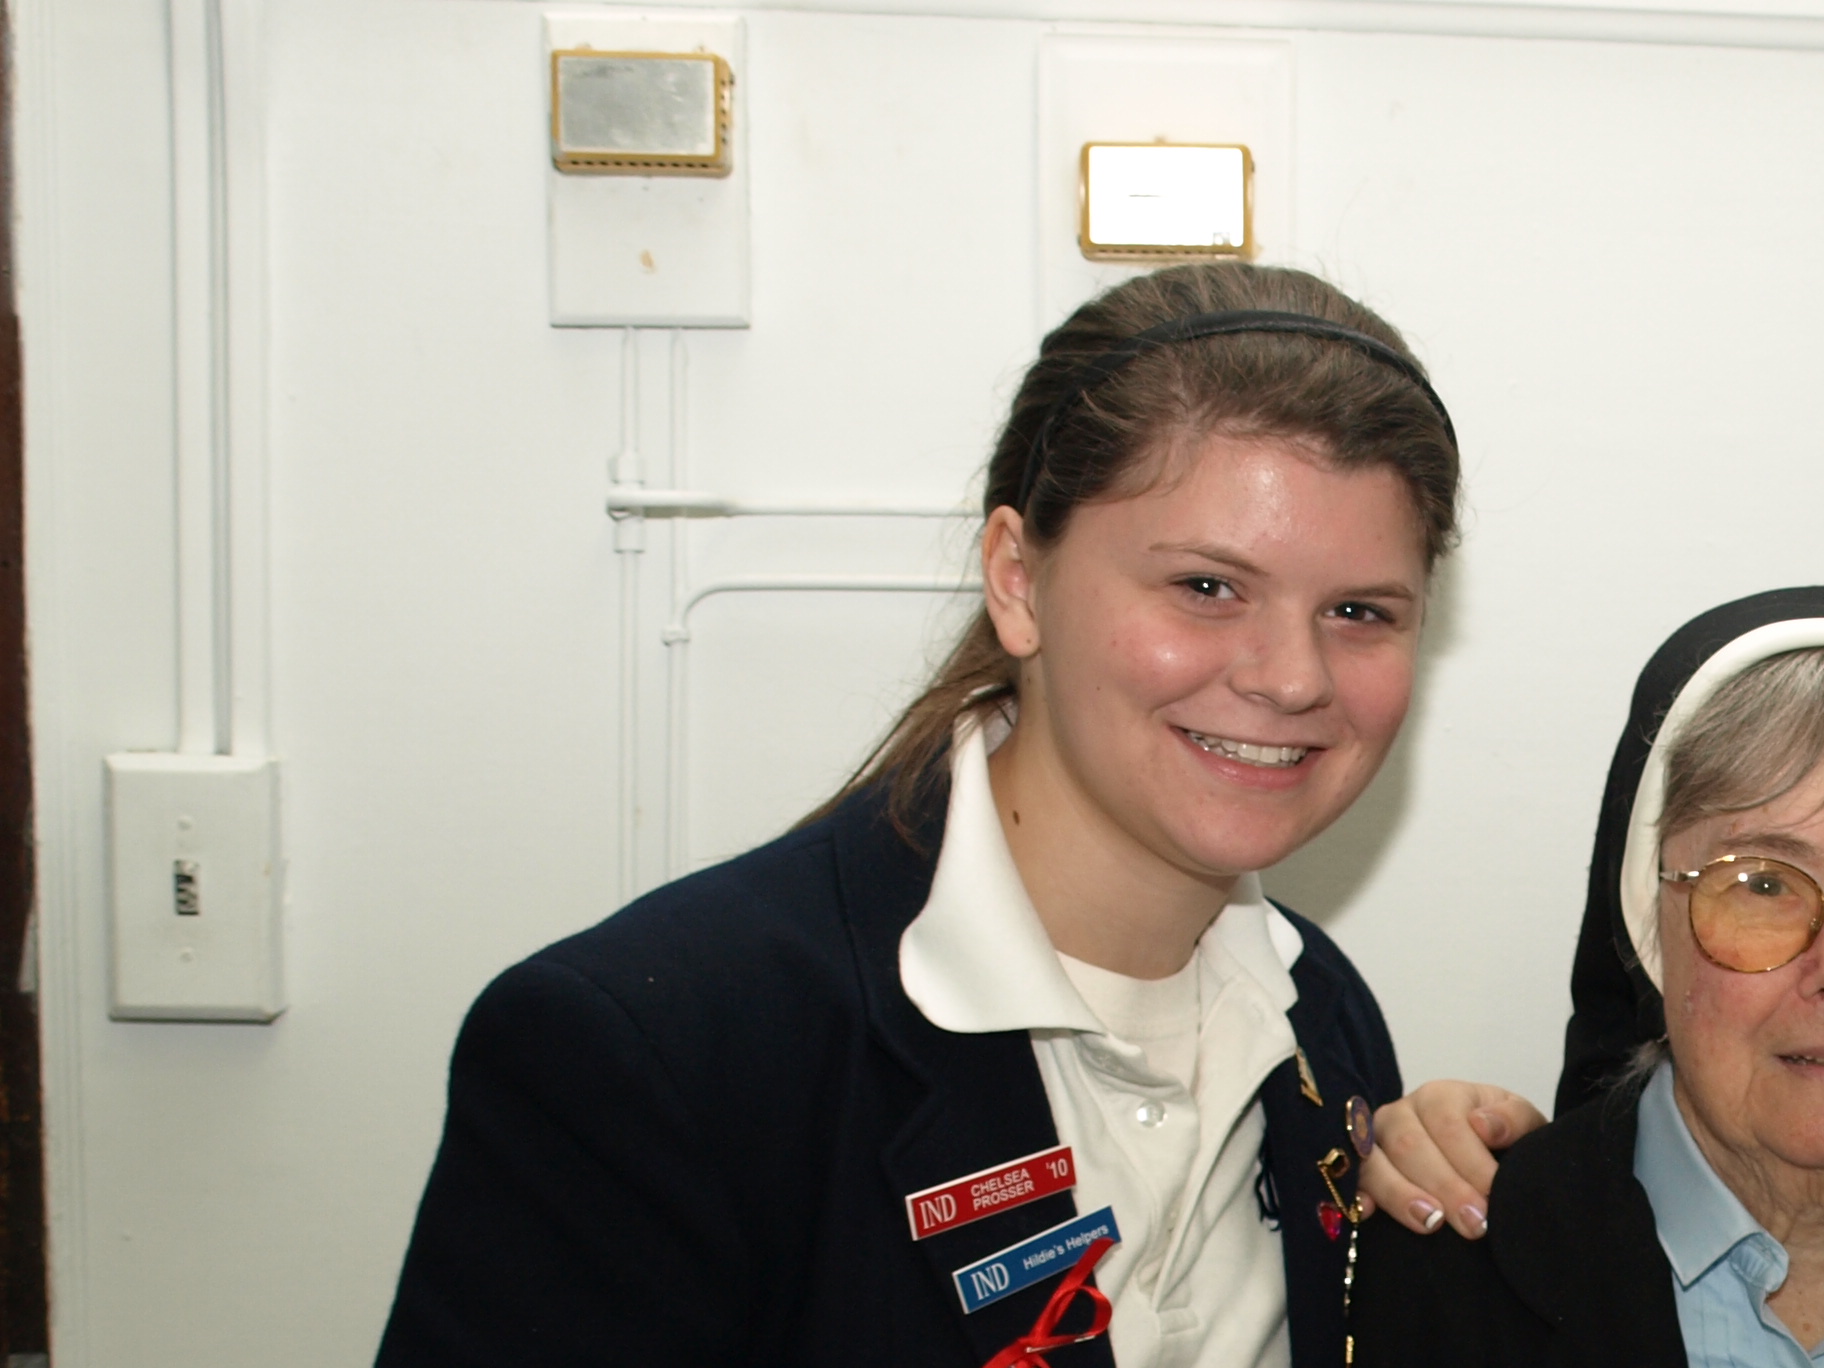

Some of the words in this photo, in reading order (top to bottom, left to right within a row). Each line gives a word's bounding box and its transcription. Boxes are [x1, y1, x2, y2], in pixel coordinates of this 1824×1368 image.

[970, 1168, 1030, 1197] CHELSEA
[1046, 1158, 1068, 1179] '10
[973, 1180, 1034, 1211] PROSSER
[919, 1193, 957, 1230] IND
[970, 1262, 1009, 1300] IND
[1023, 1245, 1064, 1270] Hildie's
[1066, 1224, 1108, 1250] Helpers
